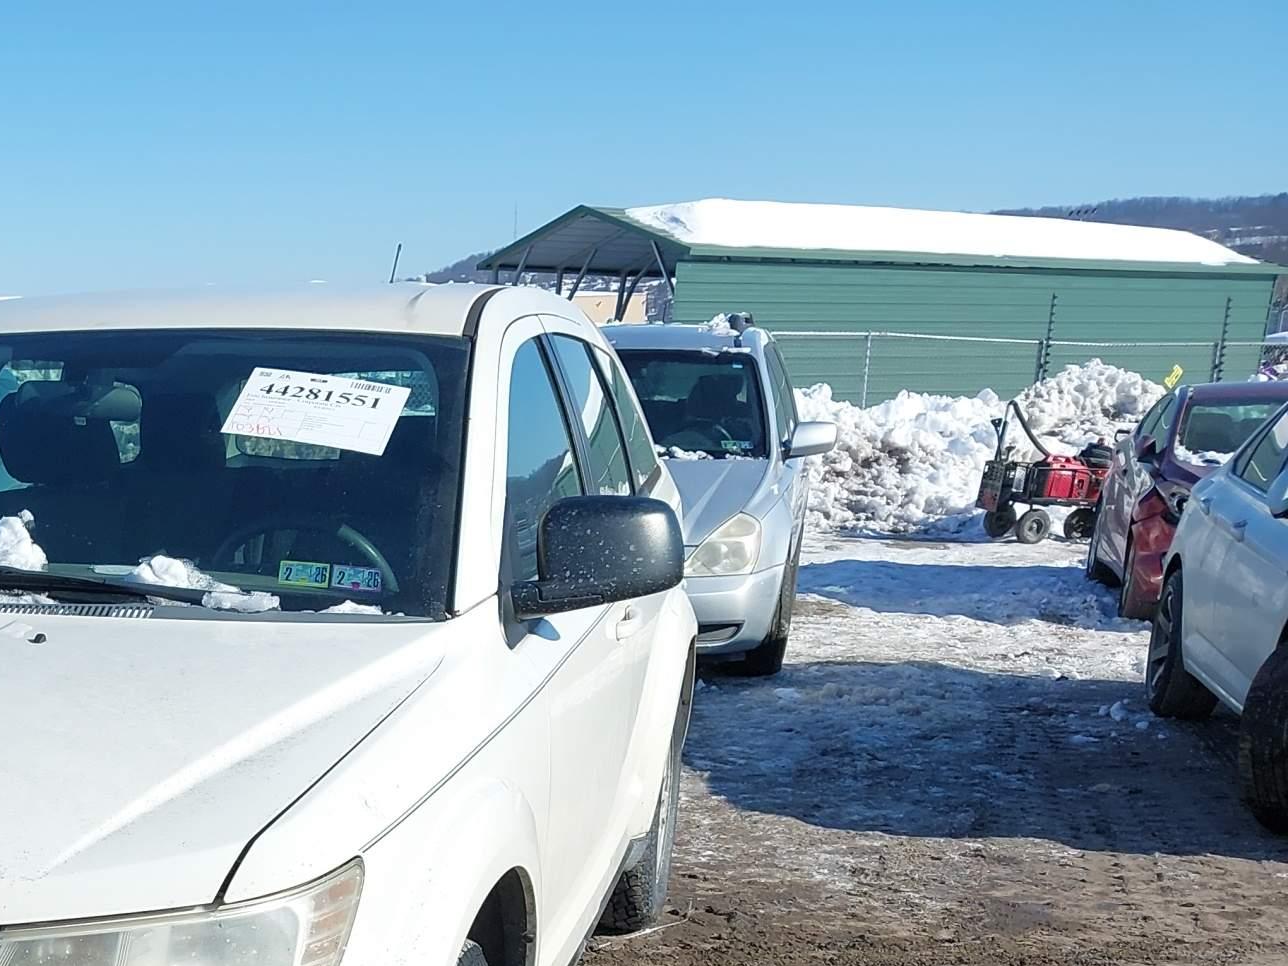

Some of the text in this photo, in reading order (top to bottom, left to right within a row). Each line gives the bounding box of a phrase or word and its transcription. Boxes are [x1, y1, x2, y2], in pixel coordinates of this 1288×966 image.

[259, 383, 383, 409] 44281551
[284, 566, 327, 583] 2 26
[337, 570, 380, 588] 2 26
